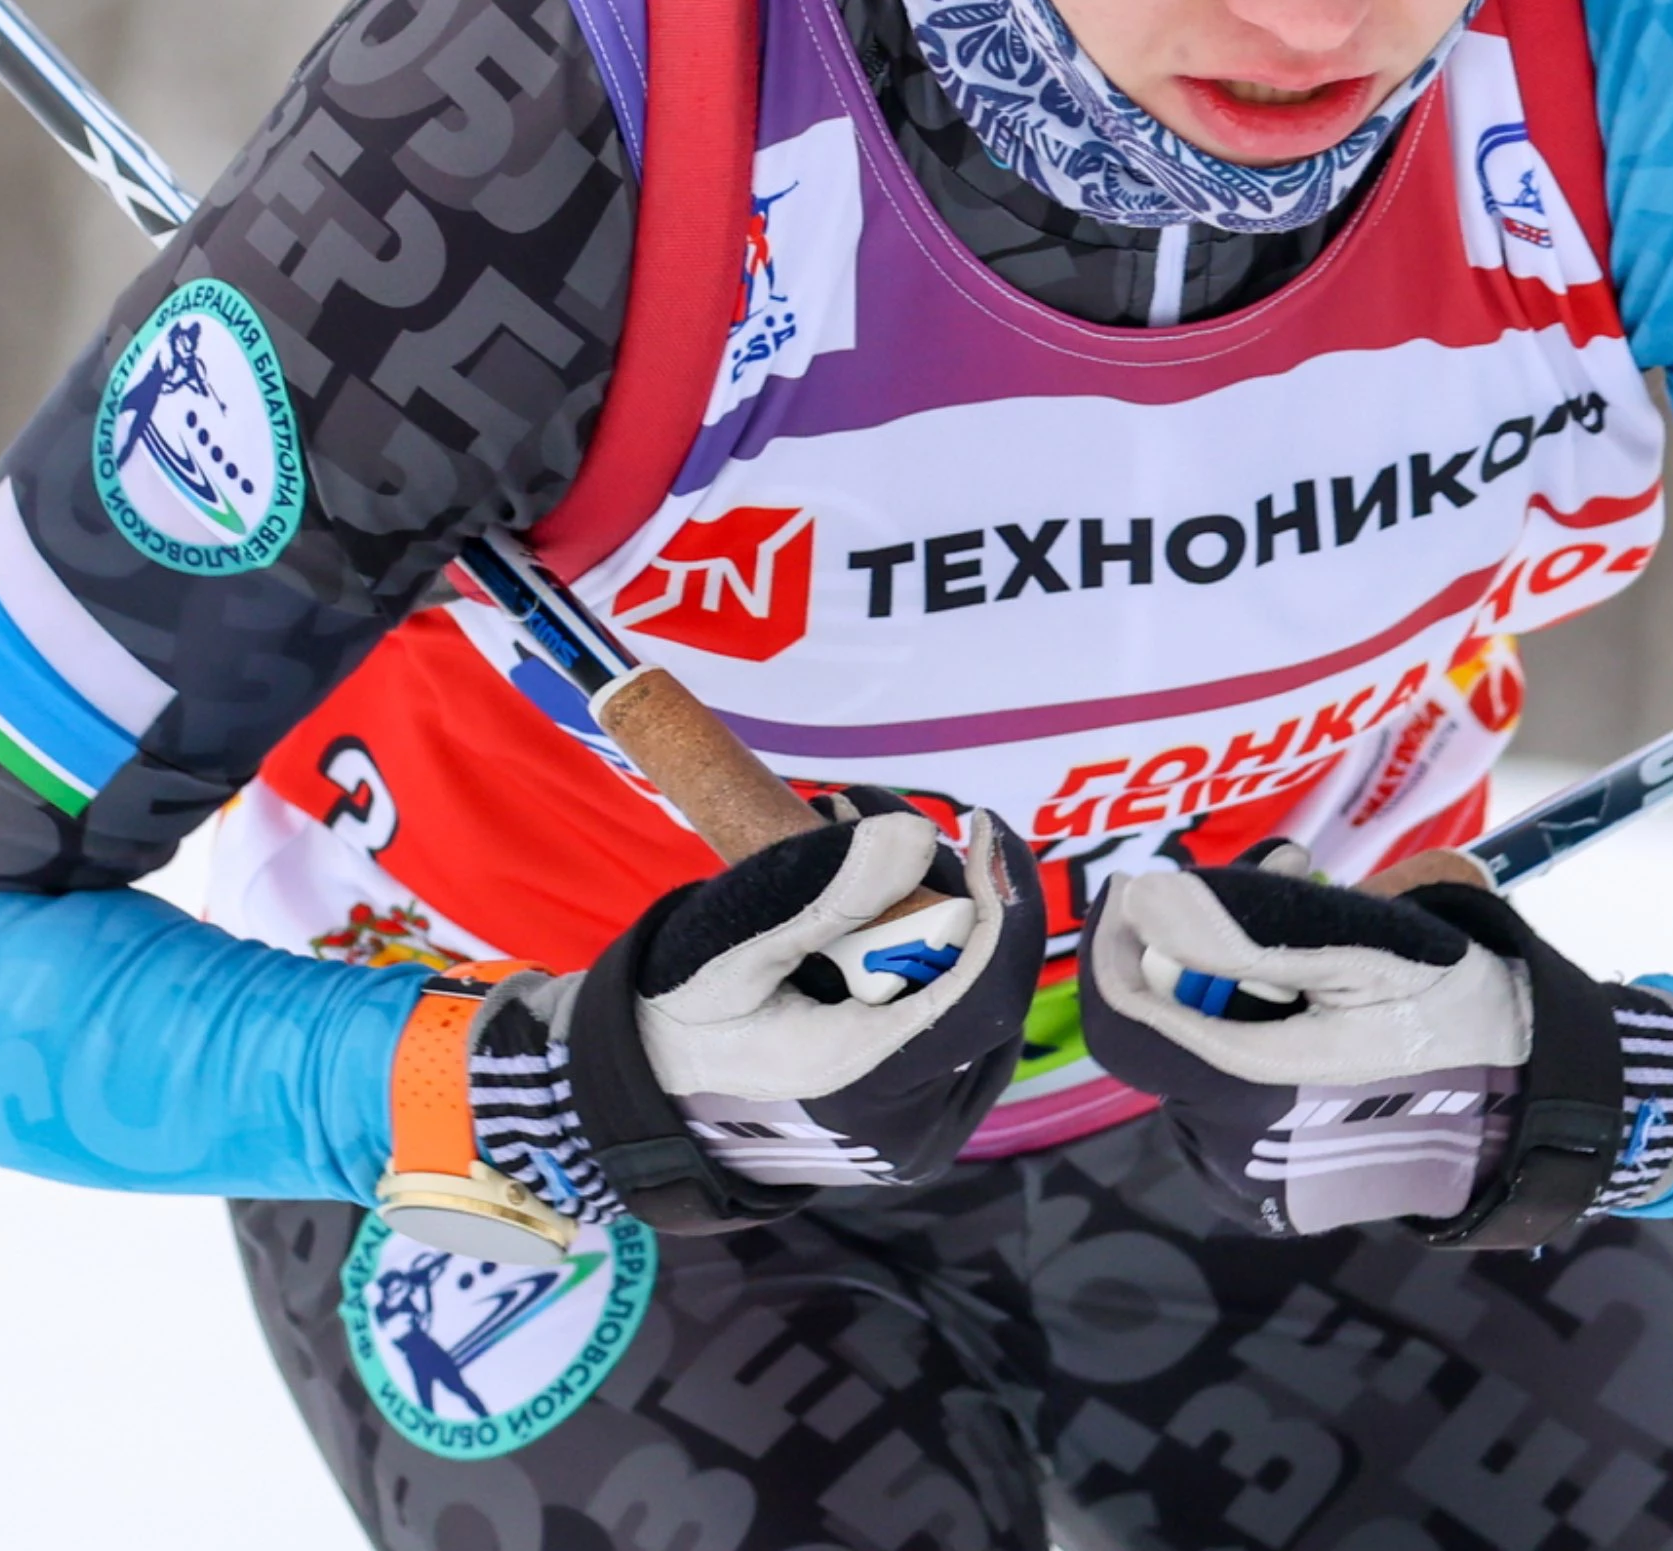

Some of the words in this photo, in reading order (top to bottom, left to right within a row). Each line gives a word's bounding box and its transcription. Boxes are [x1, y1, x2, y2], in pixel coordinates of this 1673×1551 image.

[155, 285, 262, 349] ФЕДЕРАЦИЯ
[97, 343, 143, 480] ОБЛАСТИ
[253, 352, 299, 507] БИАТЛОНА
[105, 486, 288, 569] СВЕРДЛОВСКОЙ
[1047, 661, 1429, 801] ГОНКА
[507, 1222, 647, 1440] ВЕРДЛОВСКОЙ
[377, 1380, 499, 1450] ОБЛАСТИ
